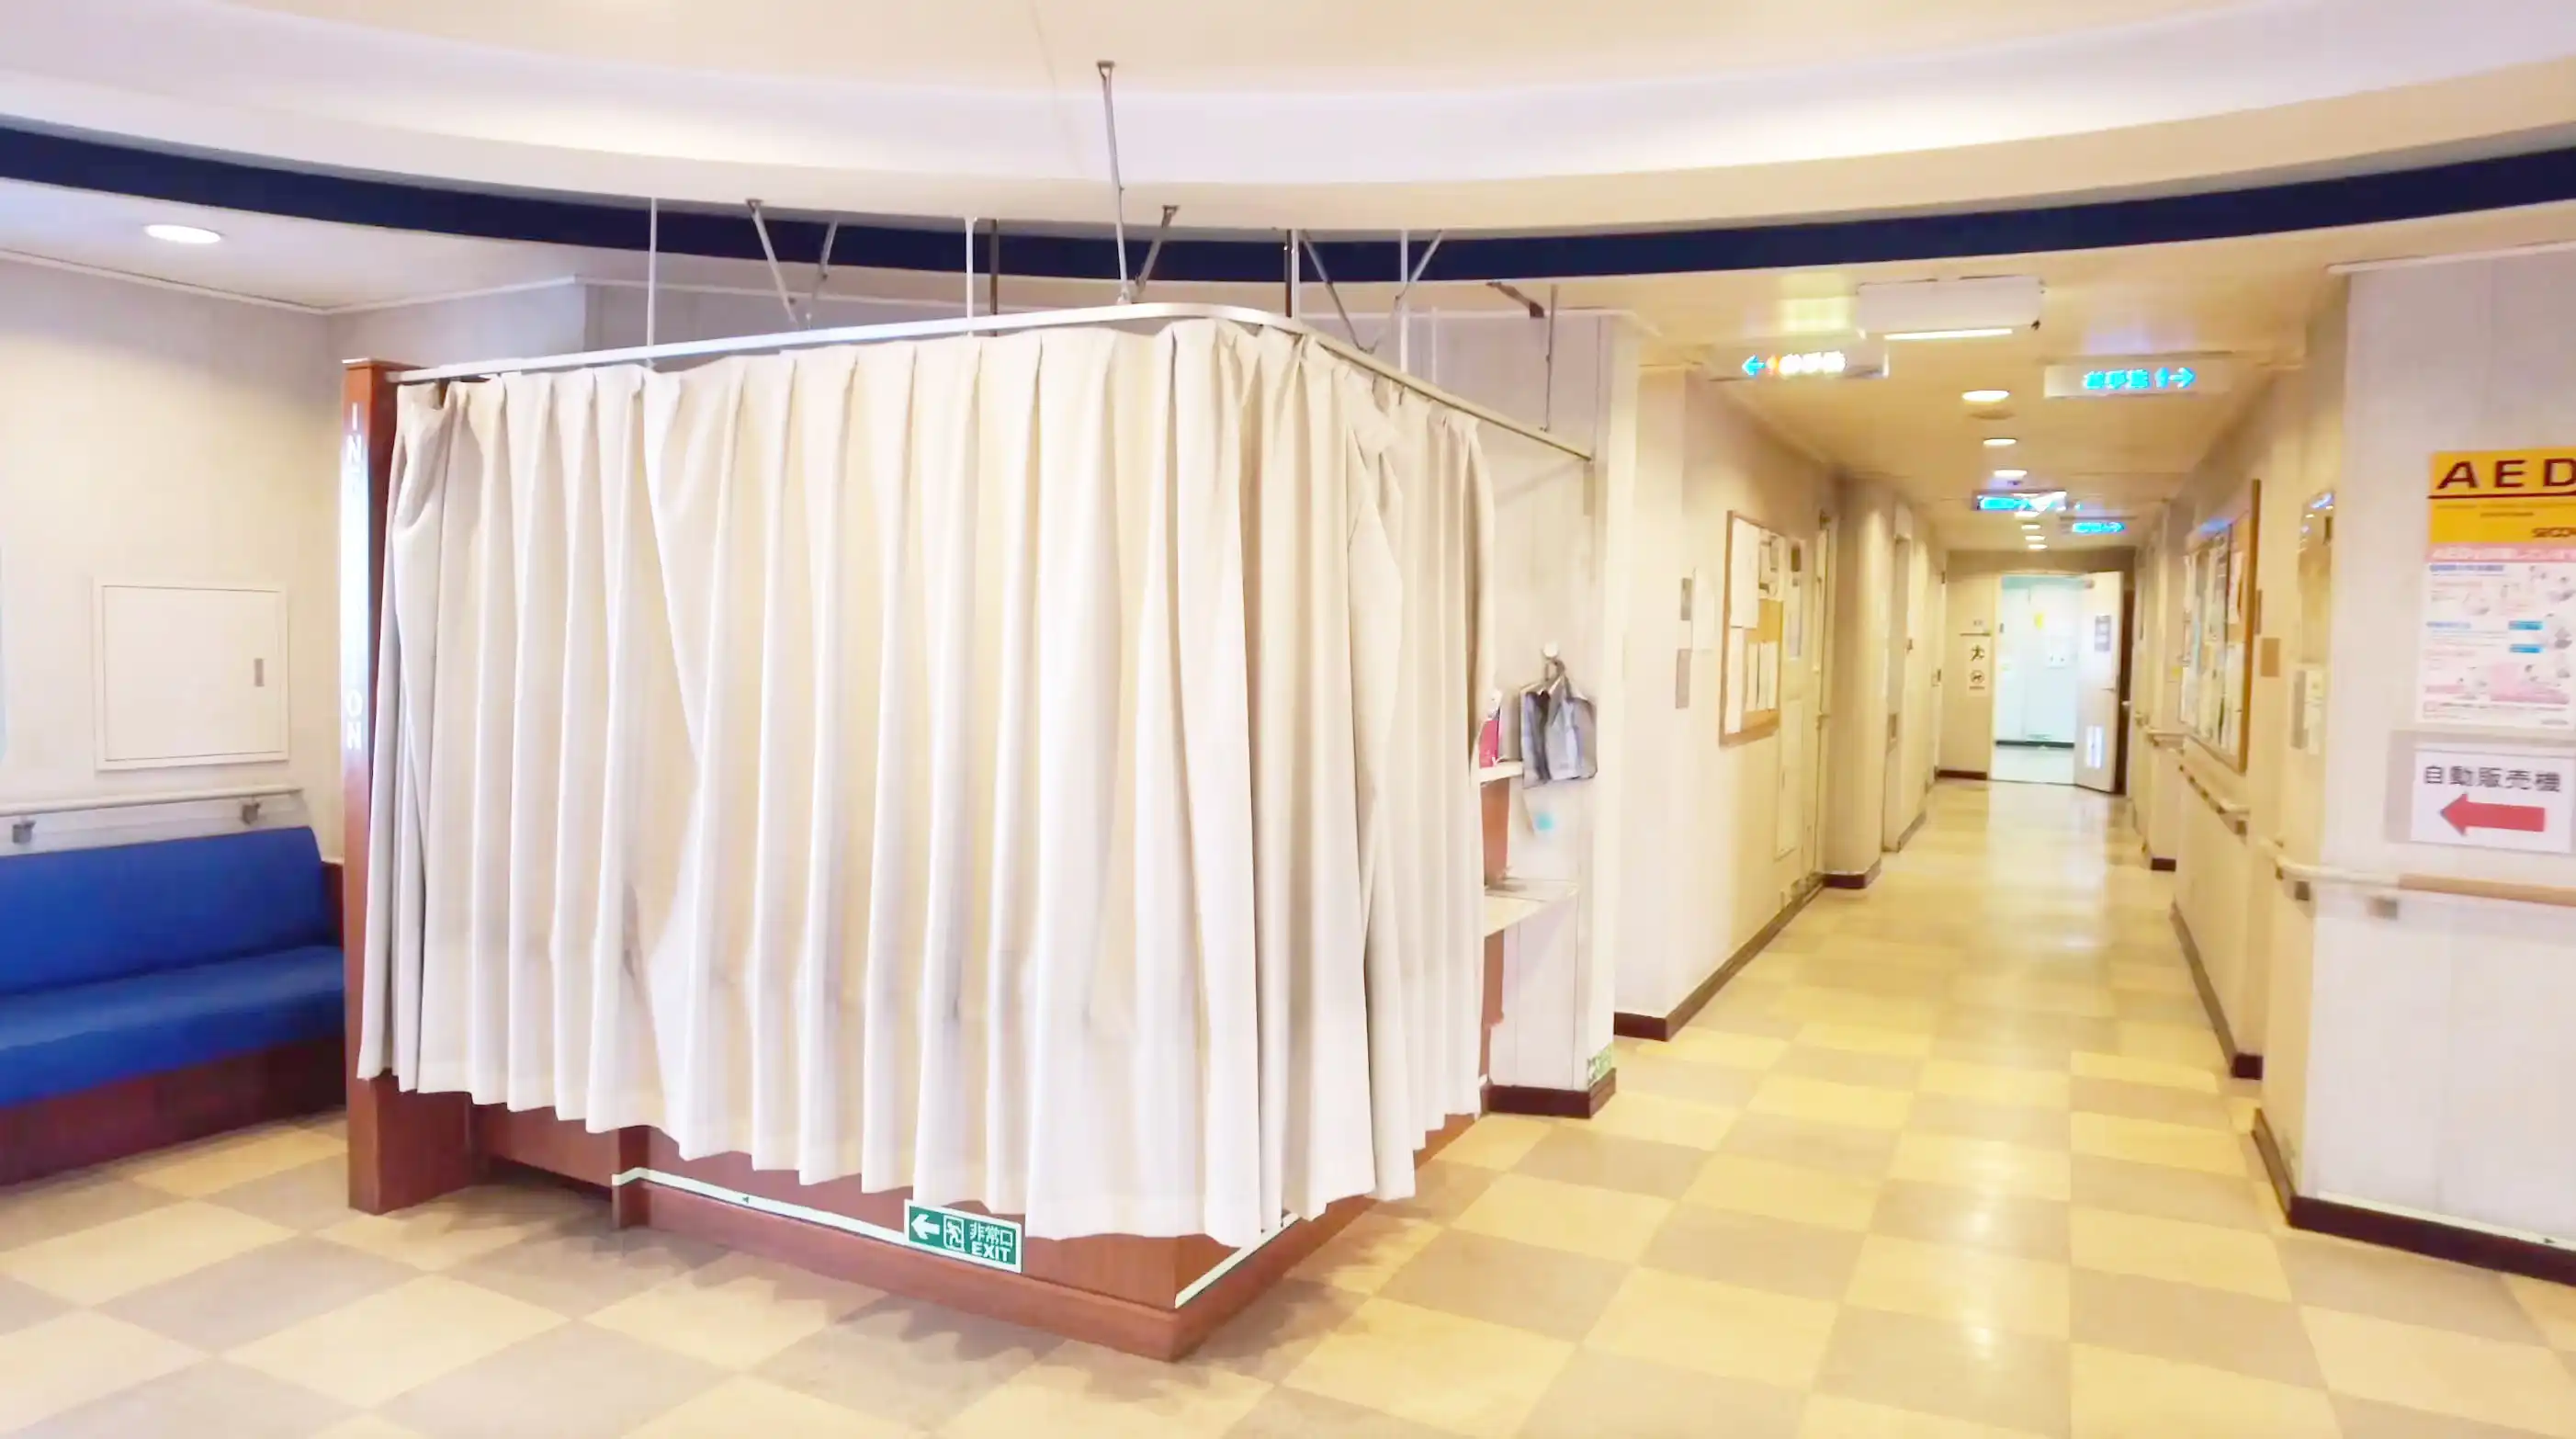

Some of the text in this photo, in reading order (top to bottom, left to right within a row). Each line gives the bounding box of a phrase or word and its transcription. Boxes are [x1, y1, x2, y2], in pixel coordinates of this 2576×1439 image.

[2436, 459, 2576, 489] AED
[2423, 764, 2561, 792] 自動販売機
[969, 1221, 1013, 1247] 非常口
[971, 1241, 1011, 1262] EXIT
